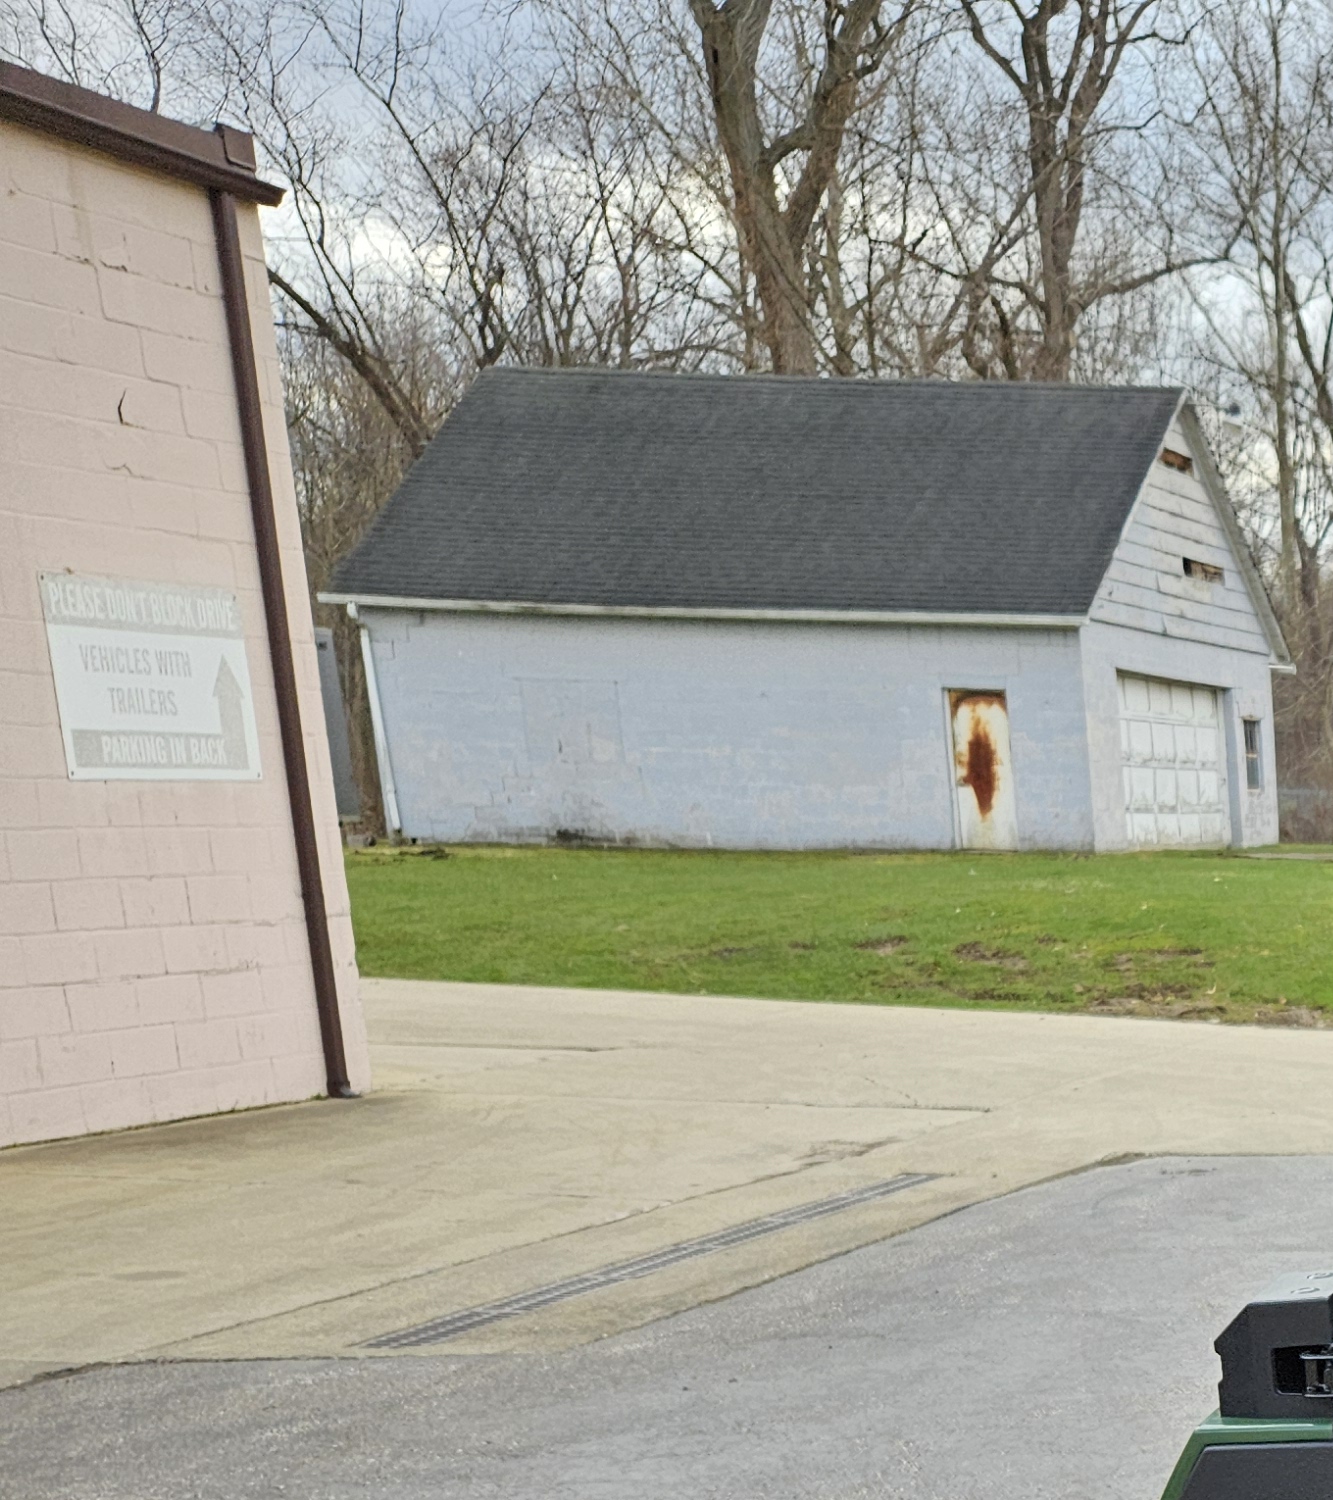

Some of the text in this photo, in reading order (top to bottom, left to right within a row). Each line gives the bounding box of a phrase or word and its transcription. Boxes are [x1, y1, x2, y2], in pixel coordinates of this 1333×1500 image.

[50, 582, 107, 620] PLEASE
[150, 593, 198, 629] BLOCK
[197, 598, 238, 632] DRIVE
[79, 645, 192, 677] VEHICLES WITH
[107, 687, 178, 716] TRAILERS
[102, 735, 228, 765] PARKING IN BACK
